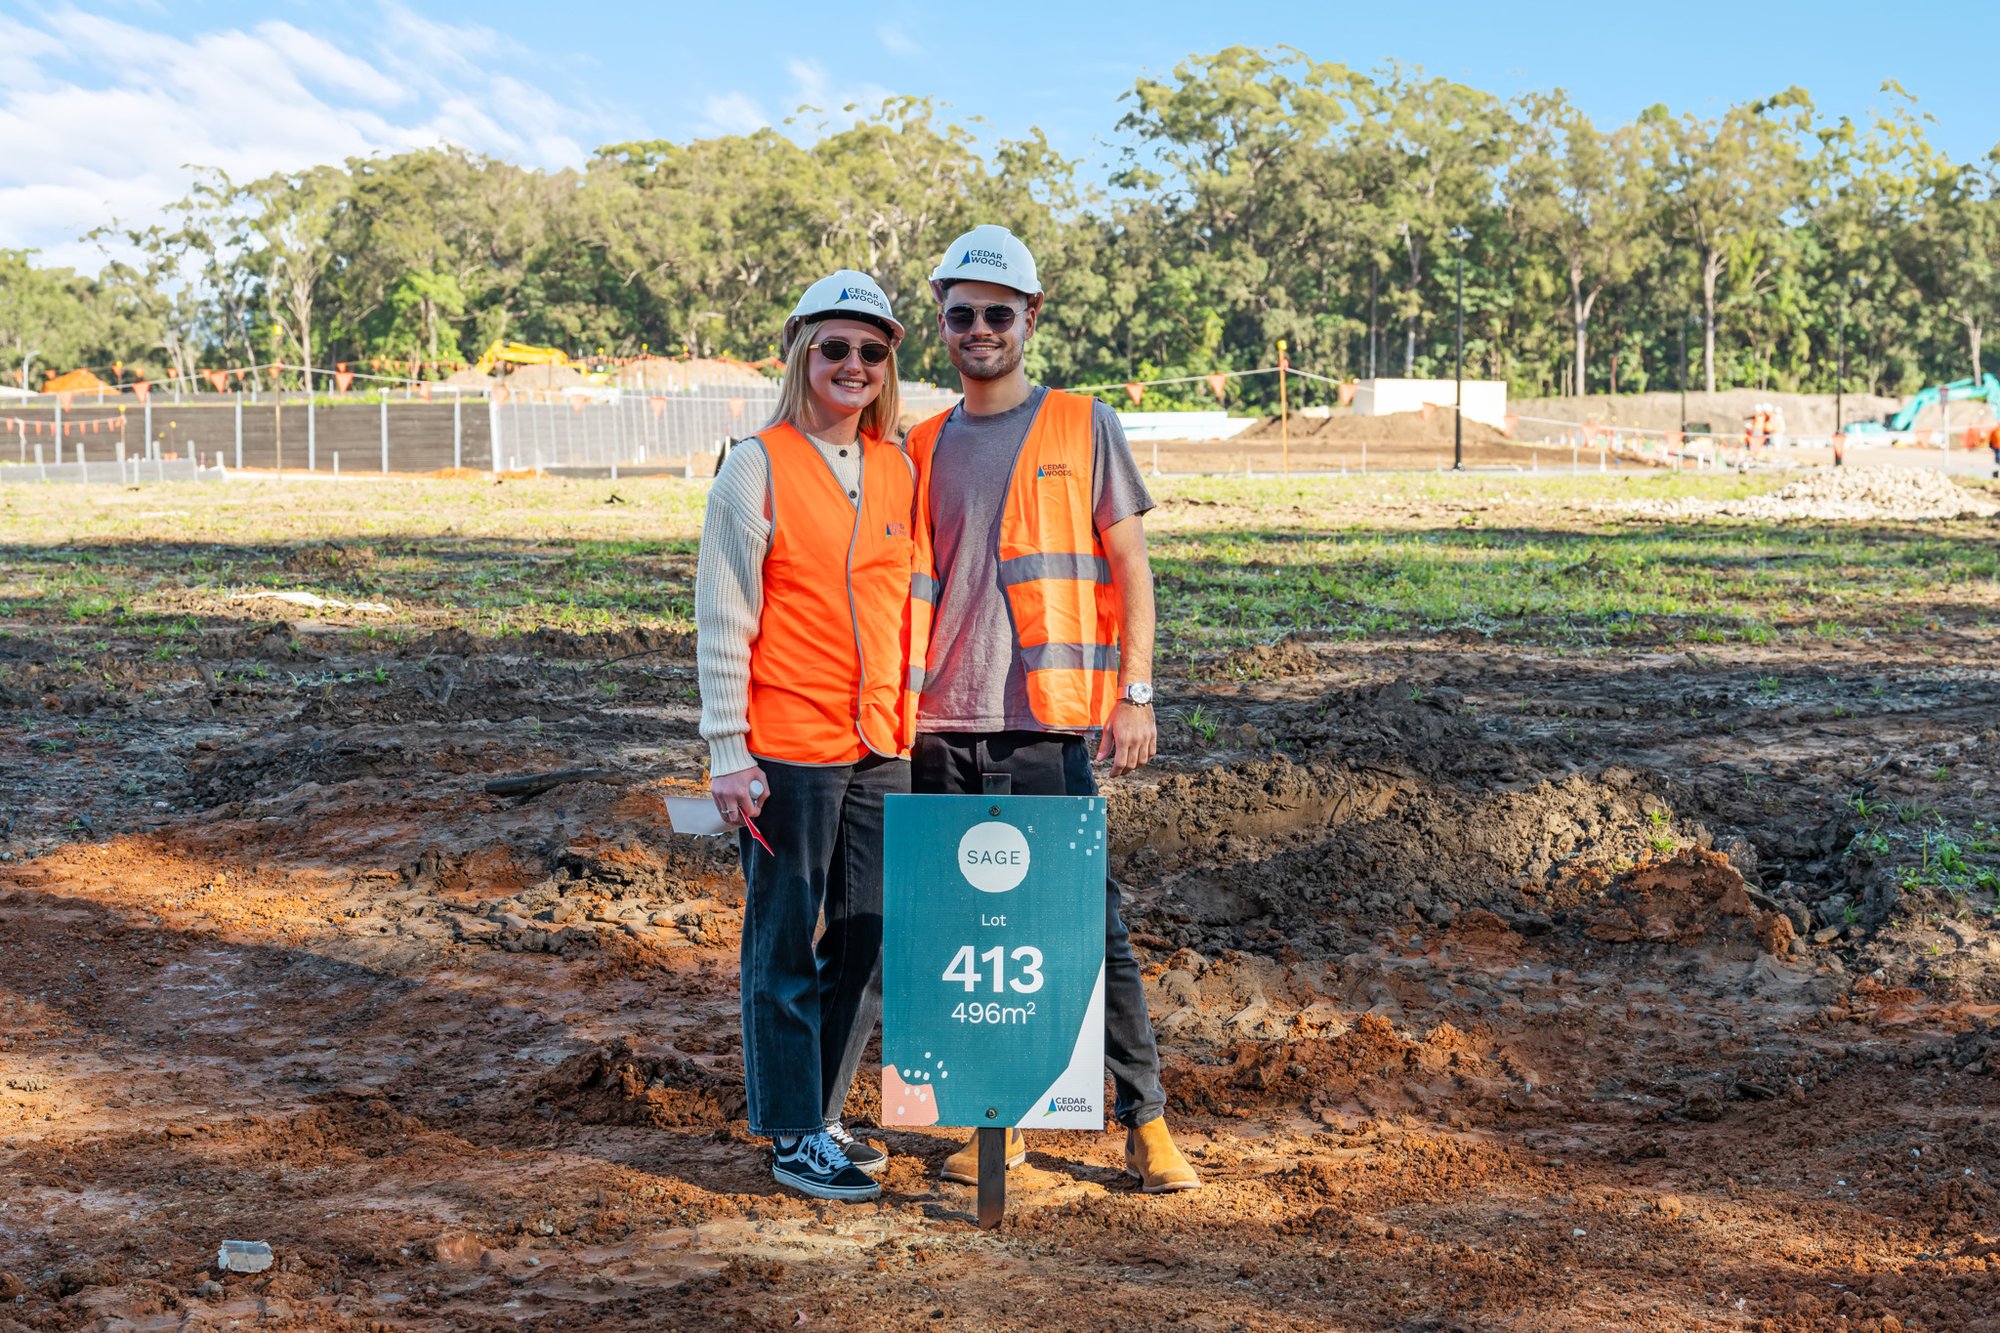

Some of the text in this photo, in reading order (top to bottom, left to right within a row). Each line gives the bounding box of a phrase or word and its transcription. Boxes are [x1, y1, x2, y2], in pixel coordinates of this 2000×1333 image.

[971, 249, 1003, 260] CEDAR
[971, 256, 1008, 270] WOODS
[848, 287, 879, 300] CEDAR
[849, 293, 884, 309] WOODS
[967, 850, 1021, 865] SAGE
[981, 914, 1007, 926] Lot
[942, 945, 1044, 994] 413
[1055, 1097, 1086, 1105] CEDAR
